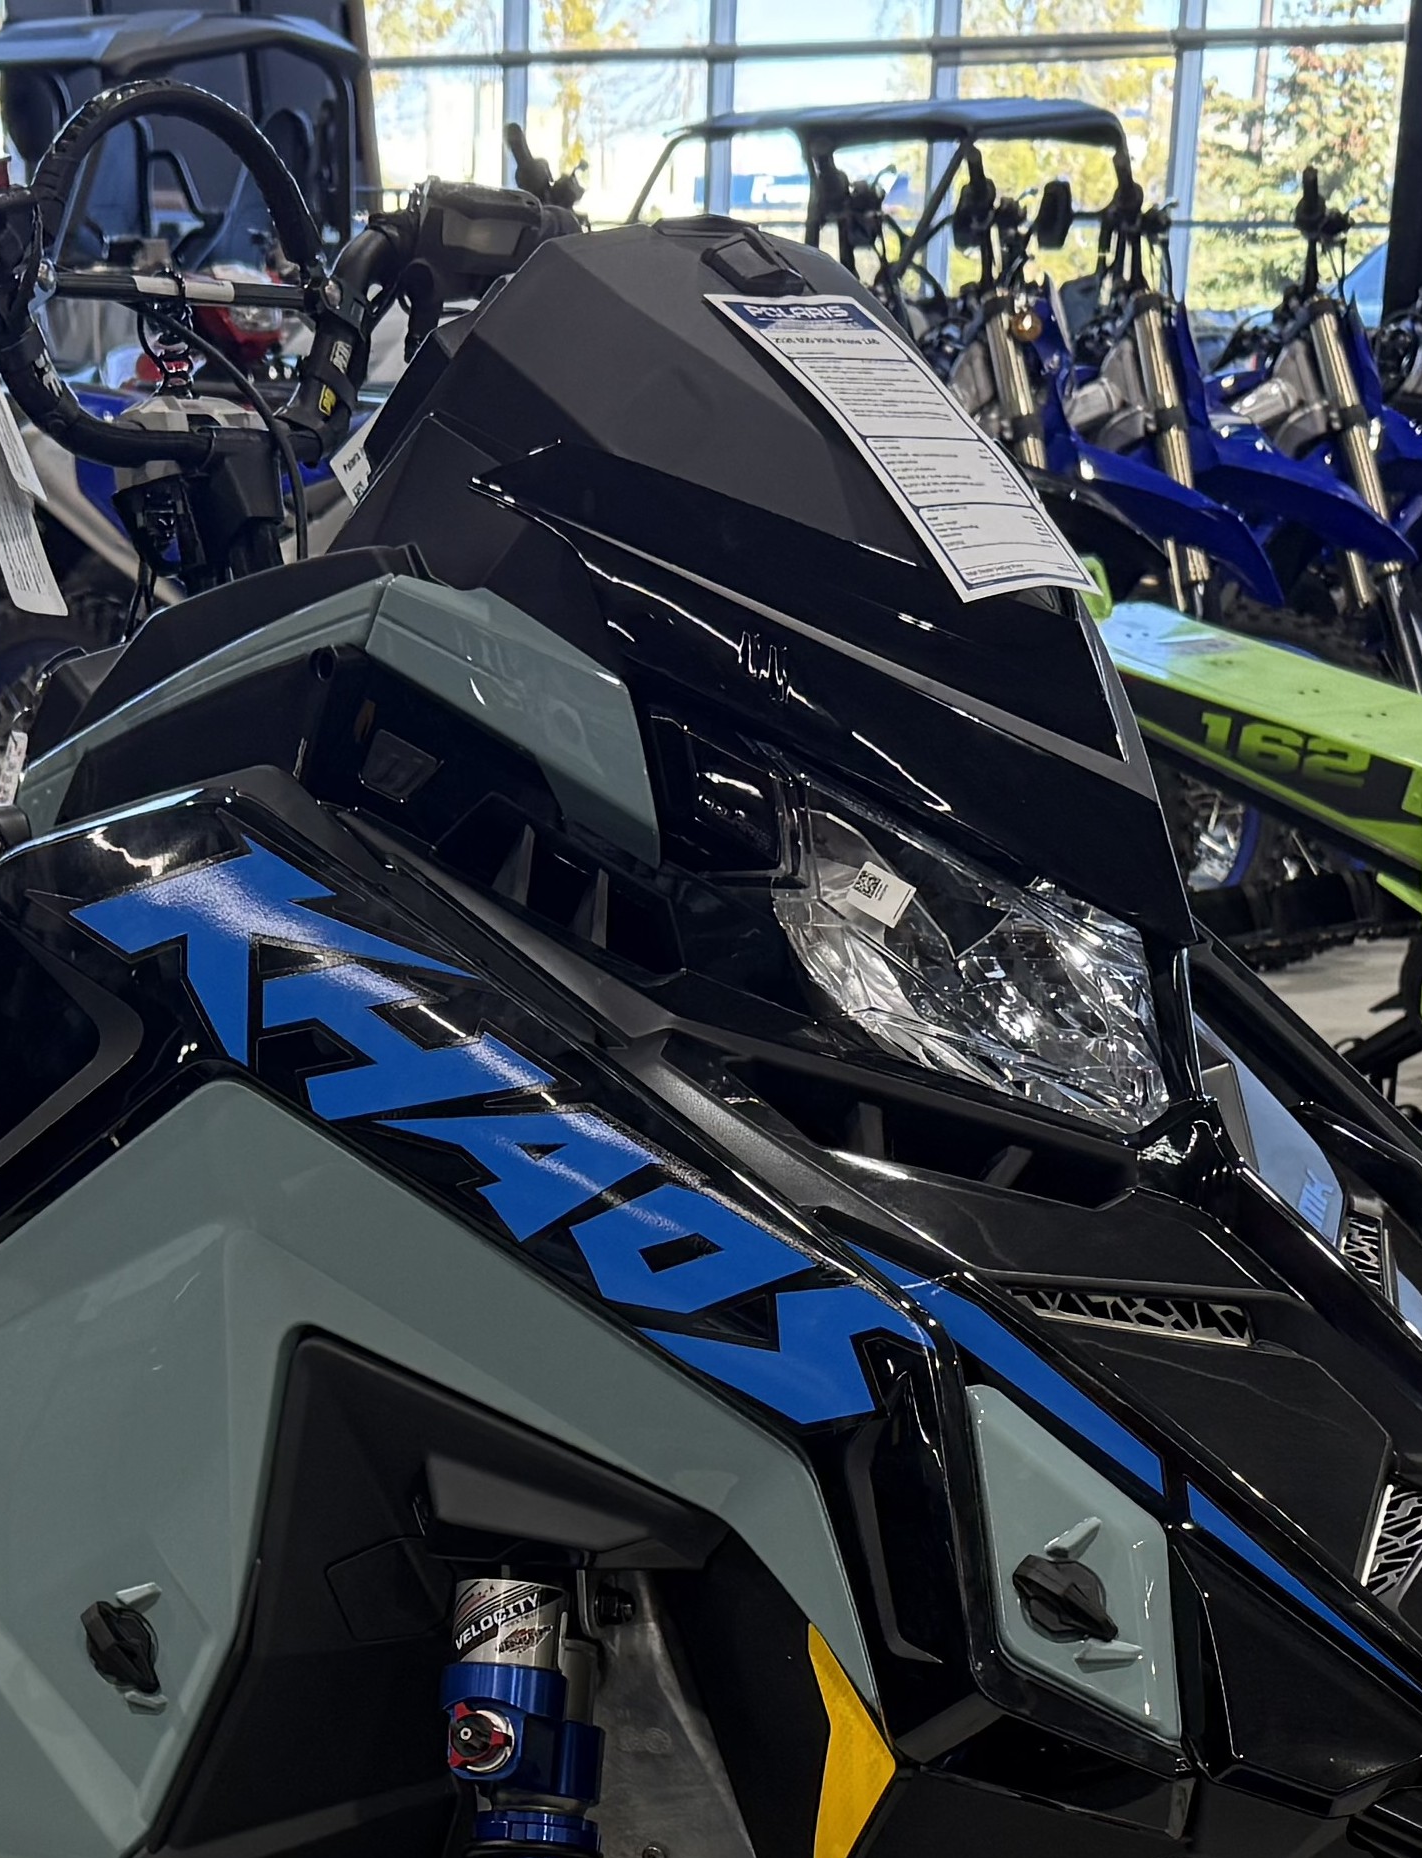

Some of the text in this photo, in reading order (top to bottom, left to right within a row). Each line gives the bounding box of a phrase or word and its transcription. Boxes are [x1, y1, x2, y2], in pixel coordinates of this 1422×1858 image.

[743, 304, 849, 319] POLARIS
[1201, 711, 1370, 788] 162
[70, 834, 935, 1424] KHAOS
[455, 1592, 538, 1651] VELOCITY
